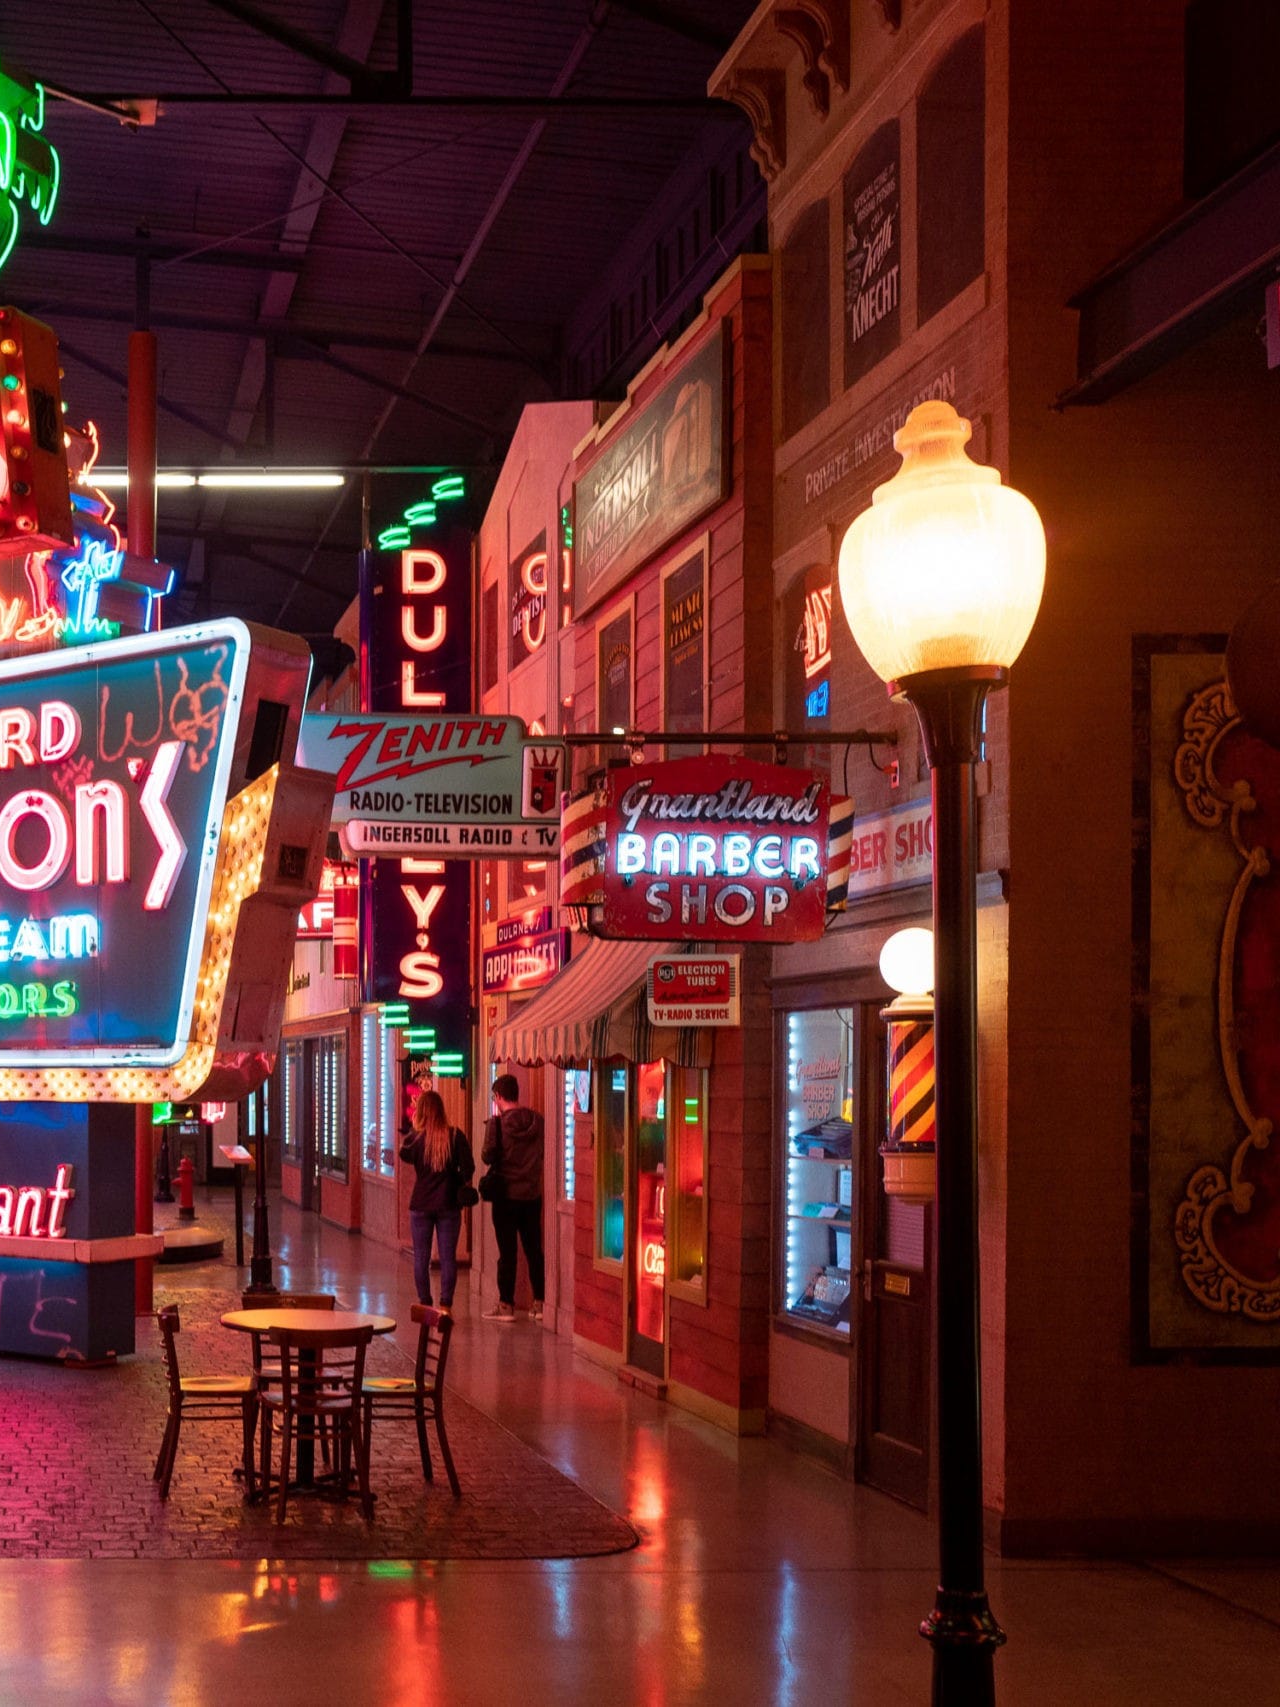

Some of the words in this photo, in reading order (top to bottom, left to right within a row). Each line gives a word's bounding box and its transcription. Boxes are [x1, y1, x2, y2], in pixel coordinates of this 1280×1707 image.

[852, 264, 899, 343] KNECHT
[580, 432, 658, 566] INGERSOLL
[806, 447, 850, 504] PRIVATE
[327, 718, 510, 793] ZENITH
[620, 779, 823, 832] Grantland
[363, 826, 450, 845] INGERSOLL
[459, 827, 513, 846] RADIO
[535, 828, 557, 847] TV
[616, 832, 821, 880] BARBER
[850, 831, 889, 874] BER
[895, 815, 932, 863] SHO
[645, 881, 789, 928] SHOP
[486, 941, 556, 984] APPLIANCES
[677, 964, 726, 975] ELECTRON
[686, 976, 717, 987] TUBES
[695, 1008, 730, 1020] SERVICE
[803, 1083, 836, 1103] BARBER
[807, 1102, 831, 1121] SHOP
